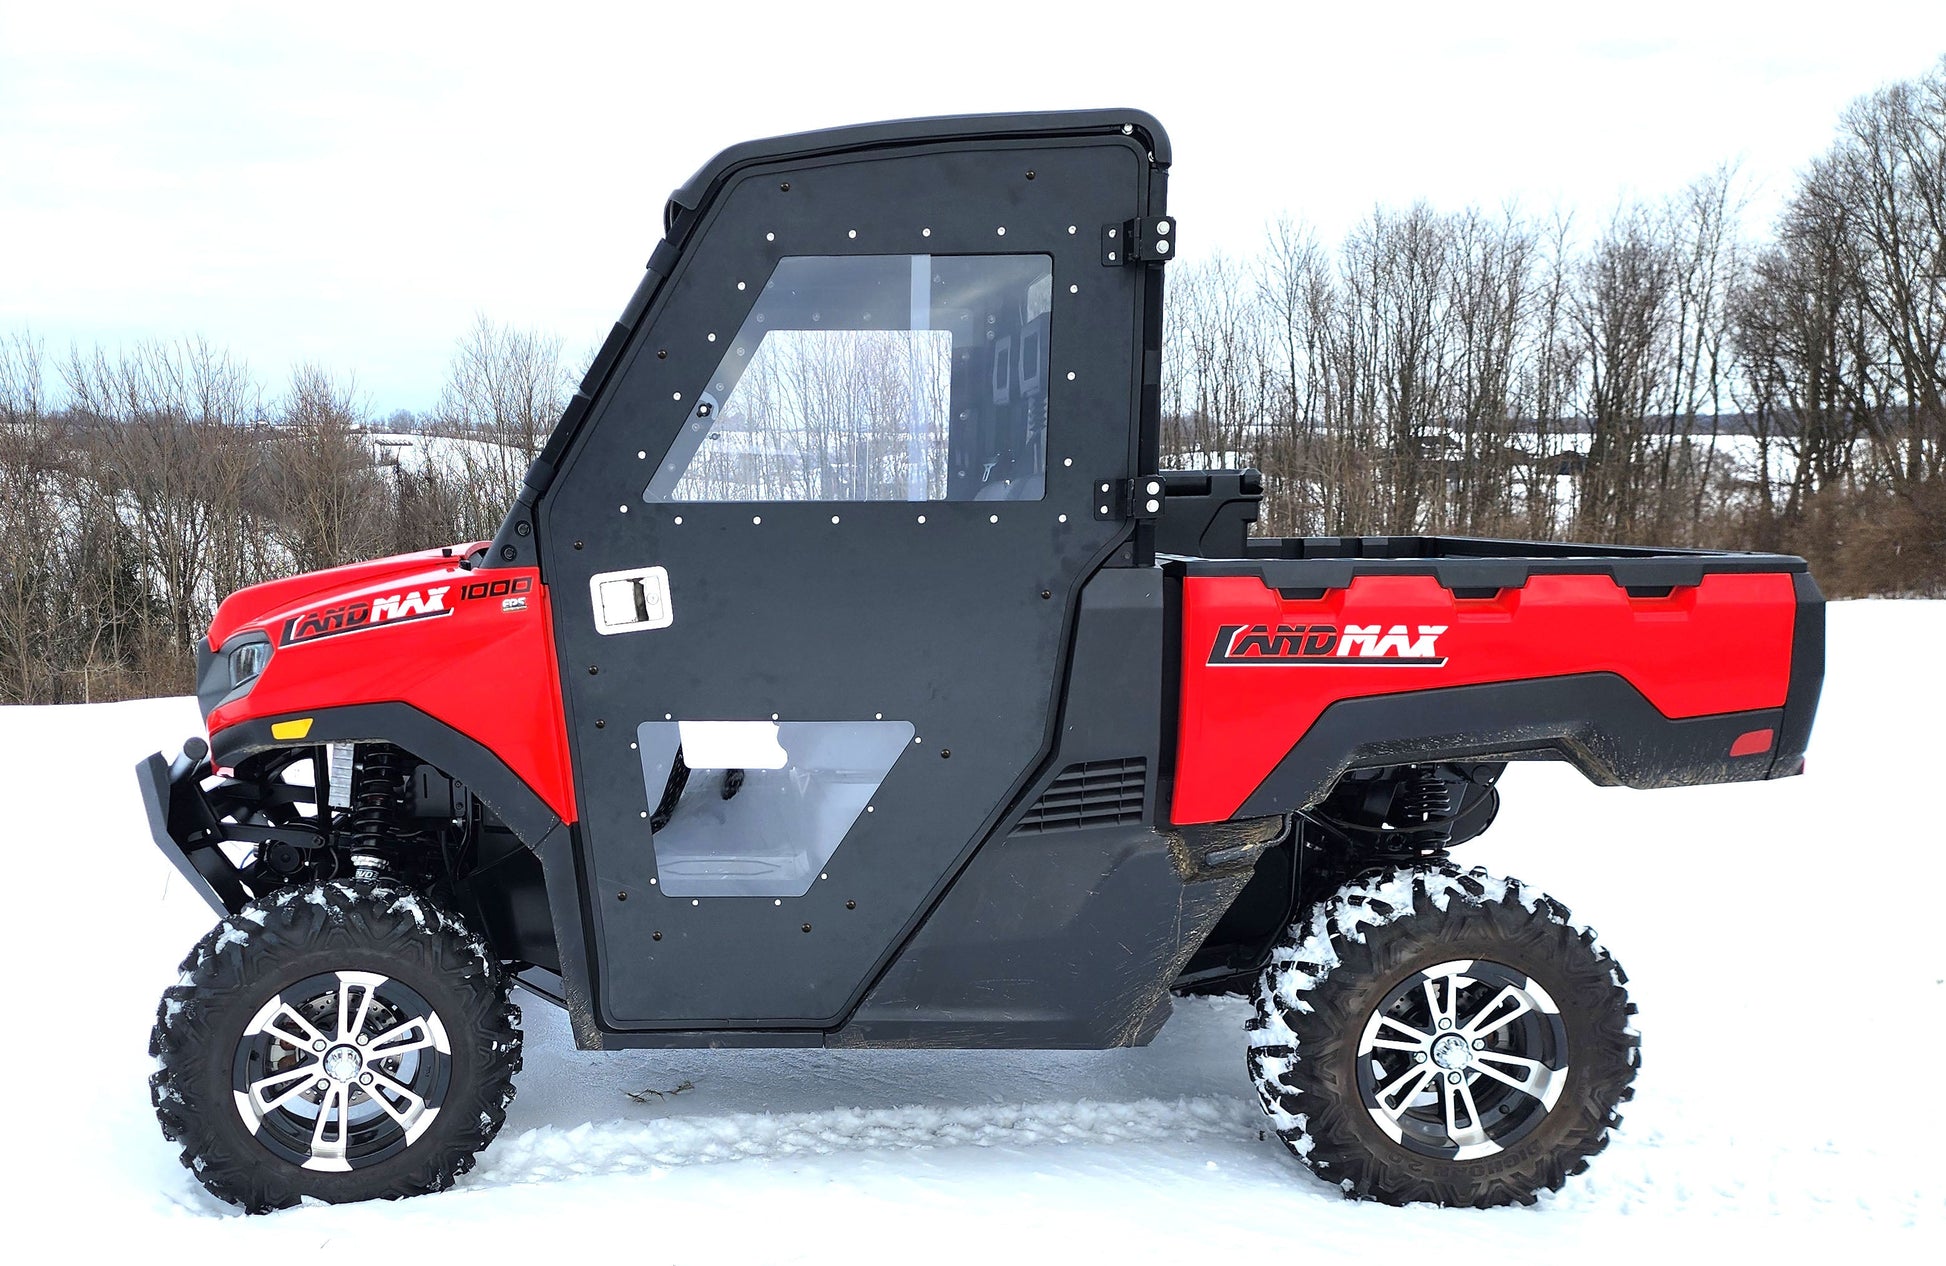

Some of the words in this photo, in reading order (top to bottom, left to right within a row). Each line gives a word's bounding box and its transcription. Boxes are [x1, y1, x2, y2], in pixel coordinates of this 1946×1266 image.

[278, 586, 454, 649] LANDMAX
[461, 577, 532, 600] 1000
[1205, 624, 1449, 667] LANDMAX
